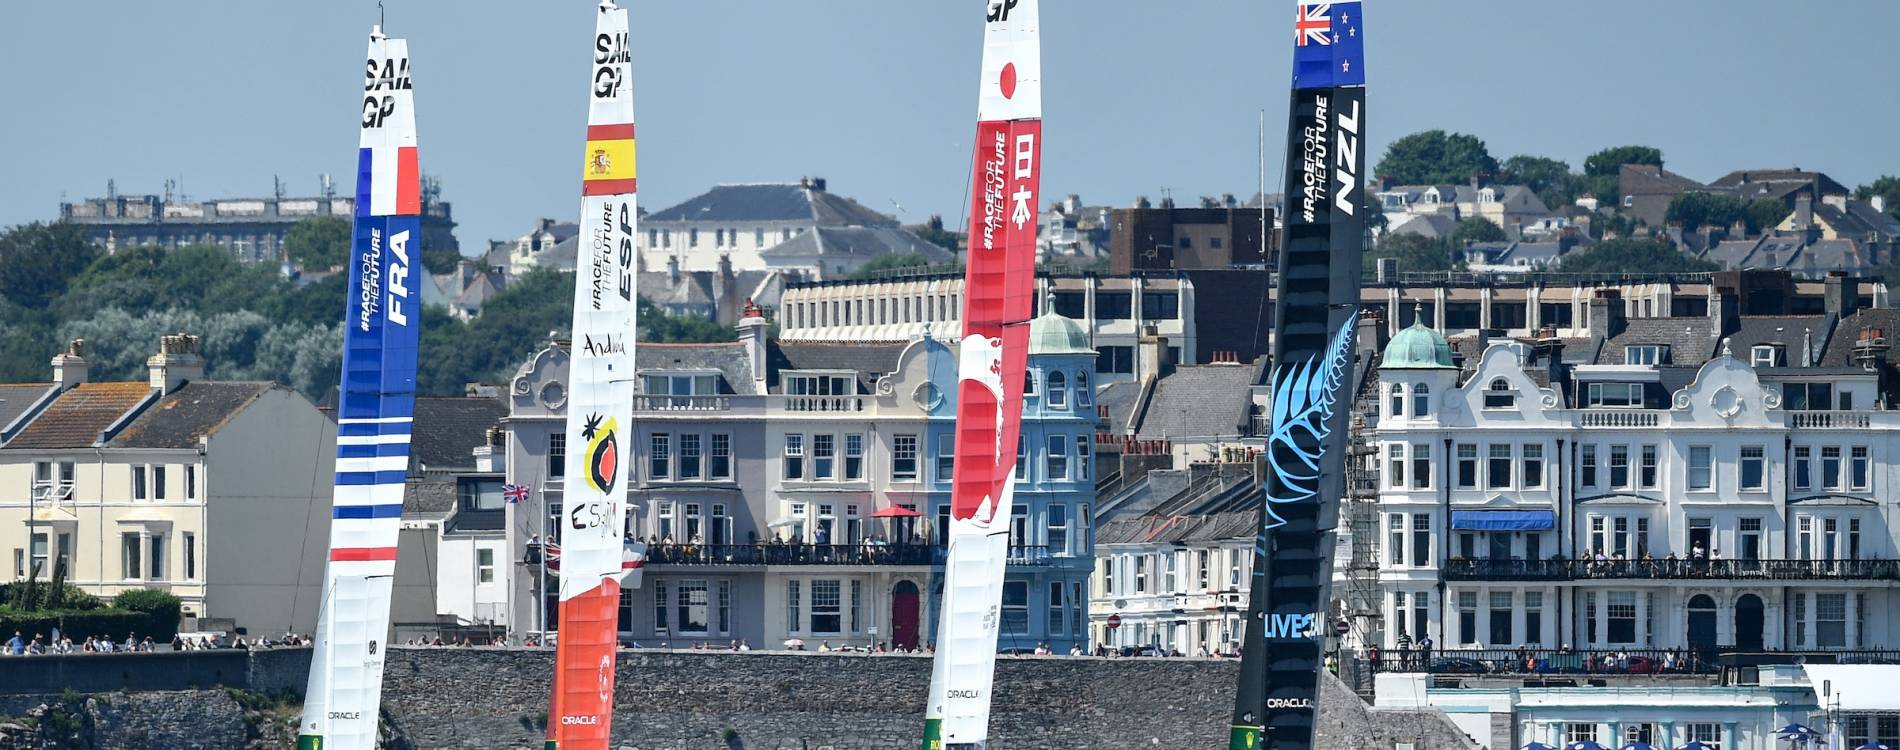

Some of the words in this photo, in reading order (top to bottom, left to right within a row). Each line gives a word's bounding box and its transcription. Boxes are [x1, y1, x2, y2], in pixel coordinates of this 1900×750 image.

[365, 58, 412, 91] SAIL
[595, 66, 622, 98] GP
[596, 33, 631, 64] SAIL
[362, 96, 395, 128] GP
[1315, 95, 1327, 201] THEFUTURE
[994, 131, 1006, 230] THEFUTURE
[1011, 133, 1034, 231] 日本
[1303, 126, 1315, 224] #RACEFOR
[1336, 100, 1359, 216] NZL
[602, 202, 612, 292] THEFUTURE
[984, 160, 995, 250] #RACEFOR
[361, 252, 371, 332] #RACEFOR
[370, 227, 380, 314] THEFUTURE
[388, 229, 410, 327] FRA
[593, 228, 603, 310] #RACEFOR
[619, 202, 632, 302] ESP
[327, 711, 360, 720] ORACLE
[561, 716, 597, 725] ORACLE
